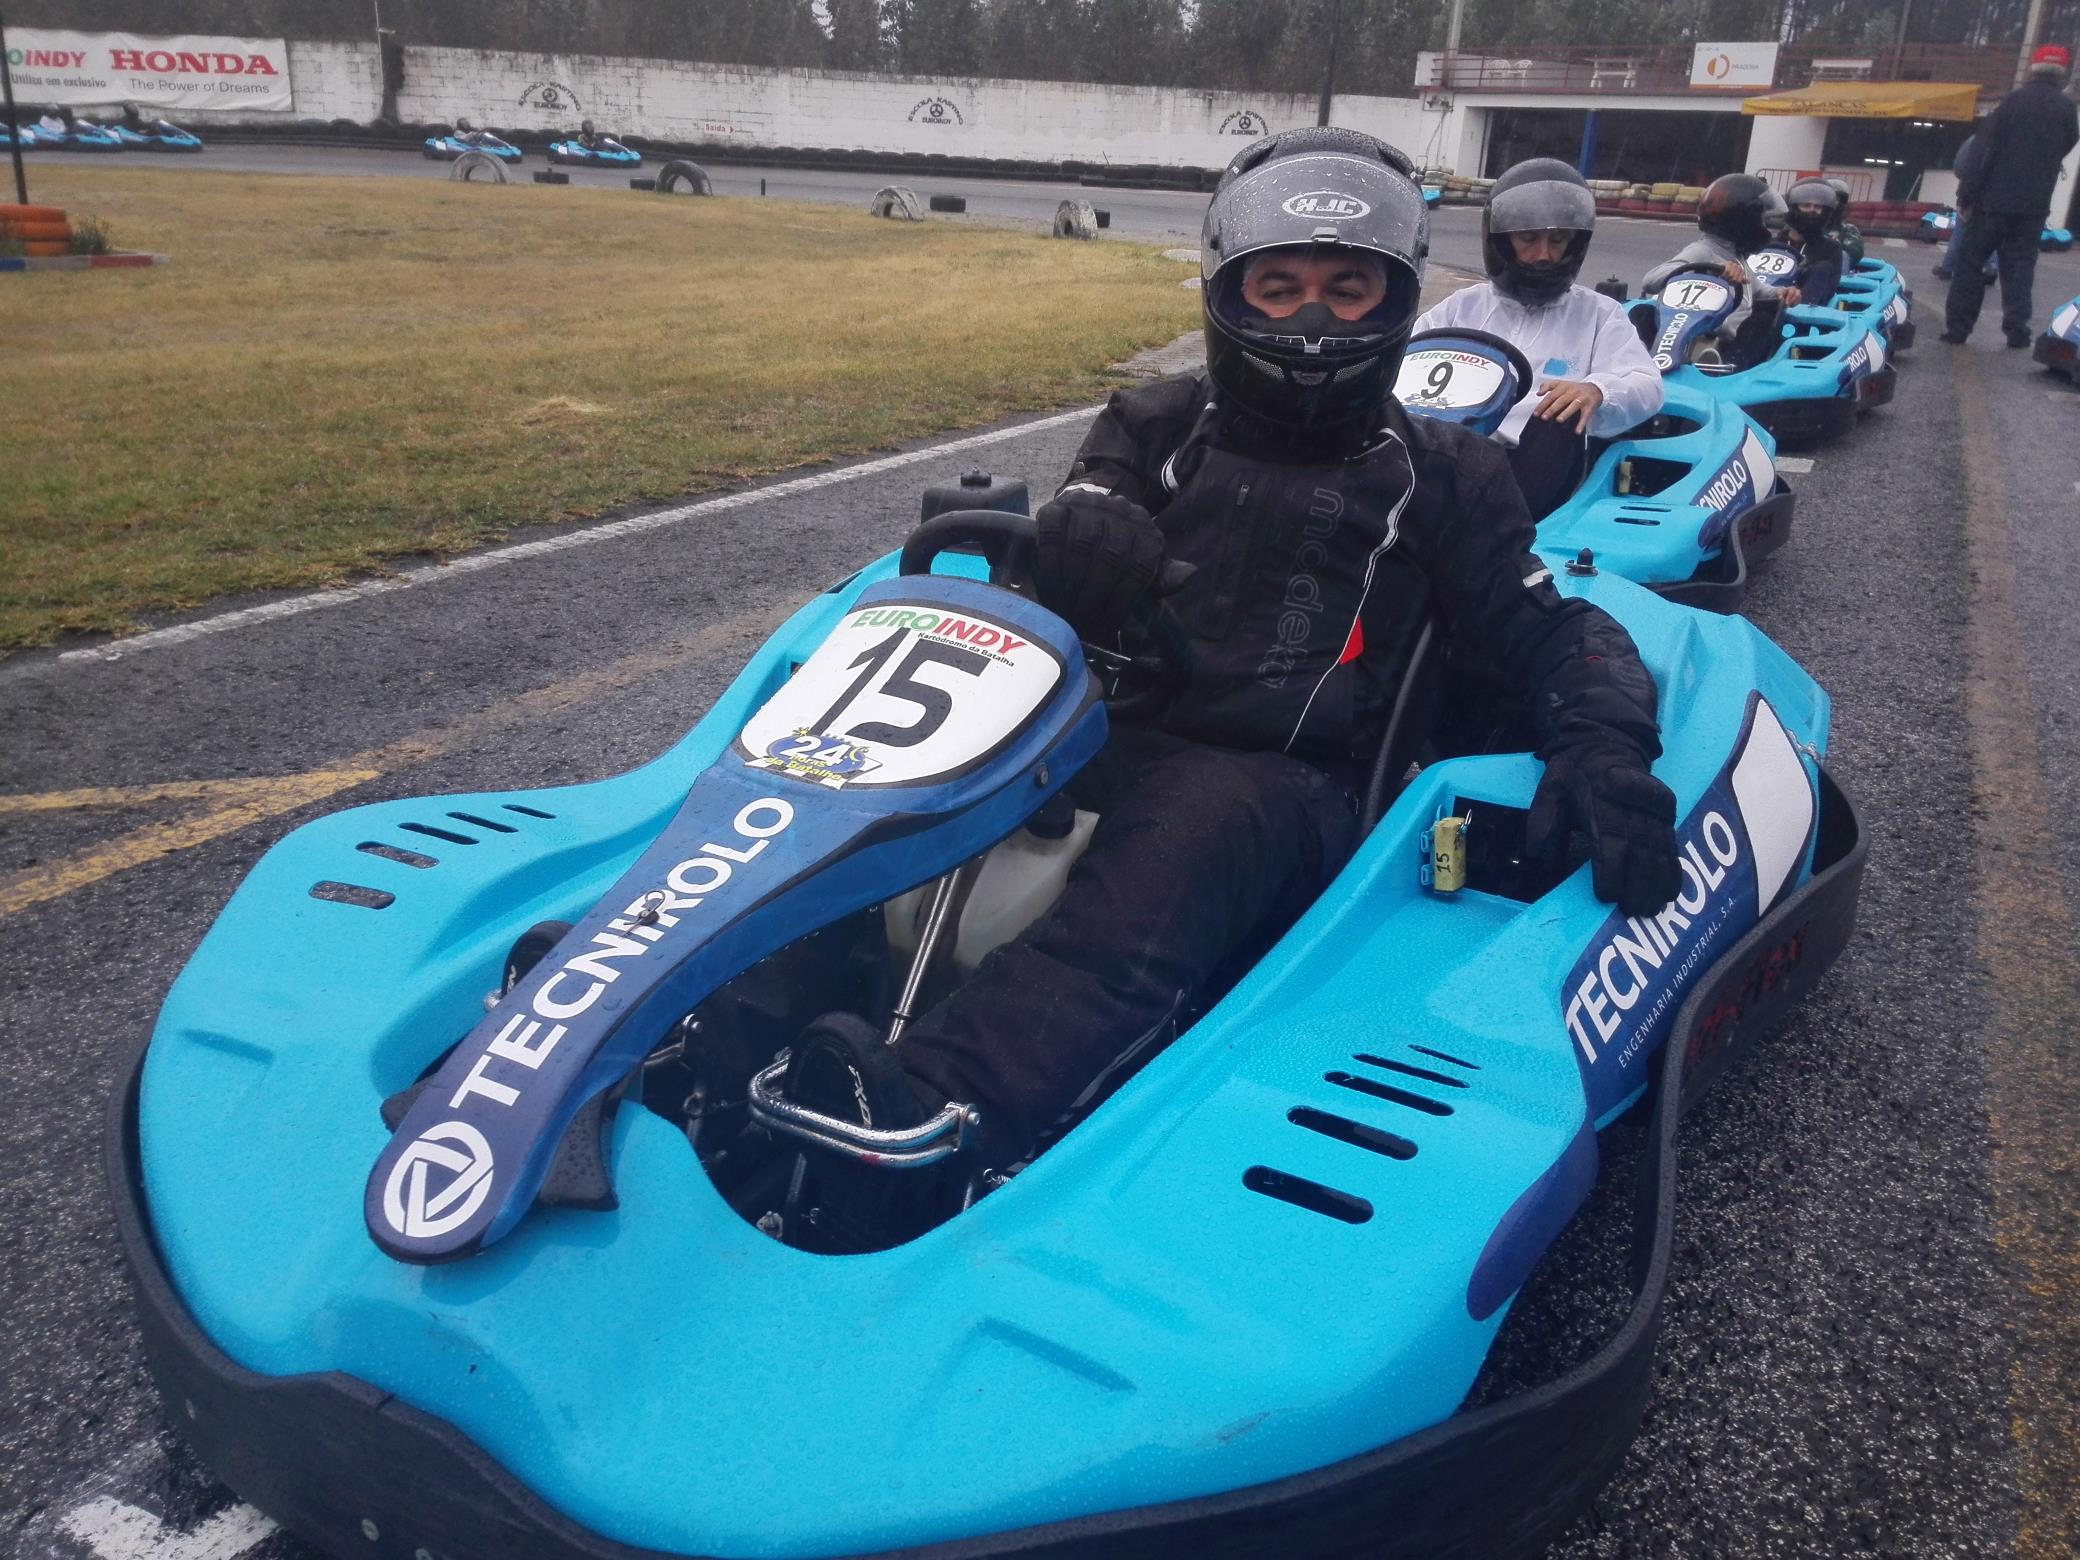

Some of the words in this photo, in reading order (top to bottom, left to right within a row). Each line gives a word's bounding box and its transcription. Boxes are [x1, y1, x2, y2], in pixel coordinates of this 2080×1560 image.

[109, 48, 279, 76] HONDA
[46, 77, 61, 86] em
[64, 76, 107, 89] exclusivo
[130, 78, 154, 90] The
[158, 80, 200, 93] Power
[203, 81, 216, 92] of
[218, 81, 271, 95] Dreams
[908, 97, 934, 122] ESCOLA
[1218, 110, 1242, 135] ESCOLA
[1295, 198, 1358, 214] HJC
[1756, 255, 1785, 272] 28
[1680, 284, 1708, 305] 17
[1409, 352, 1491, 367] EUROINDY
[1421, 361, 1454, 399] 9
[851, 609, 1028, 654] EUROINDY
[968, 645, 980, 654] da
[981, 649, 1015, 668] Batalha
[846, 627, 991, 748] 15
[779, 736, 852, 766] 24
[765, 757, 785, 766] da
[787, 761, 843, 781] Batalha
[1435, 852, 1452, 873] 15
[449, 797, 794, 1108] TECNIROLO
[1618, 988, 1674, 1069] ENGENHARIA
